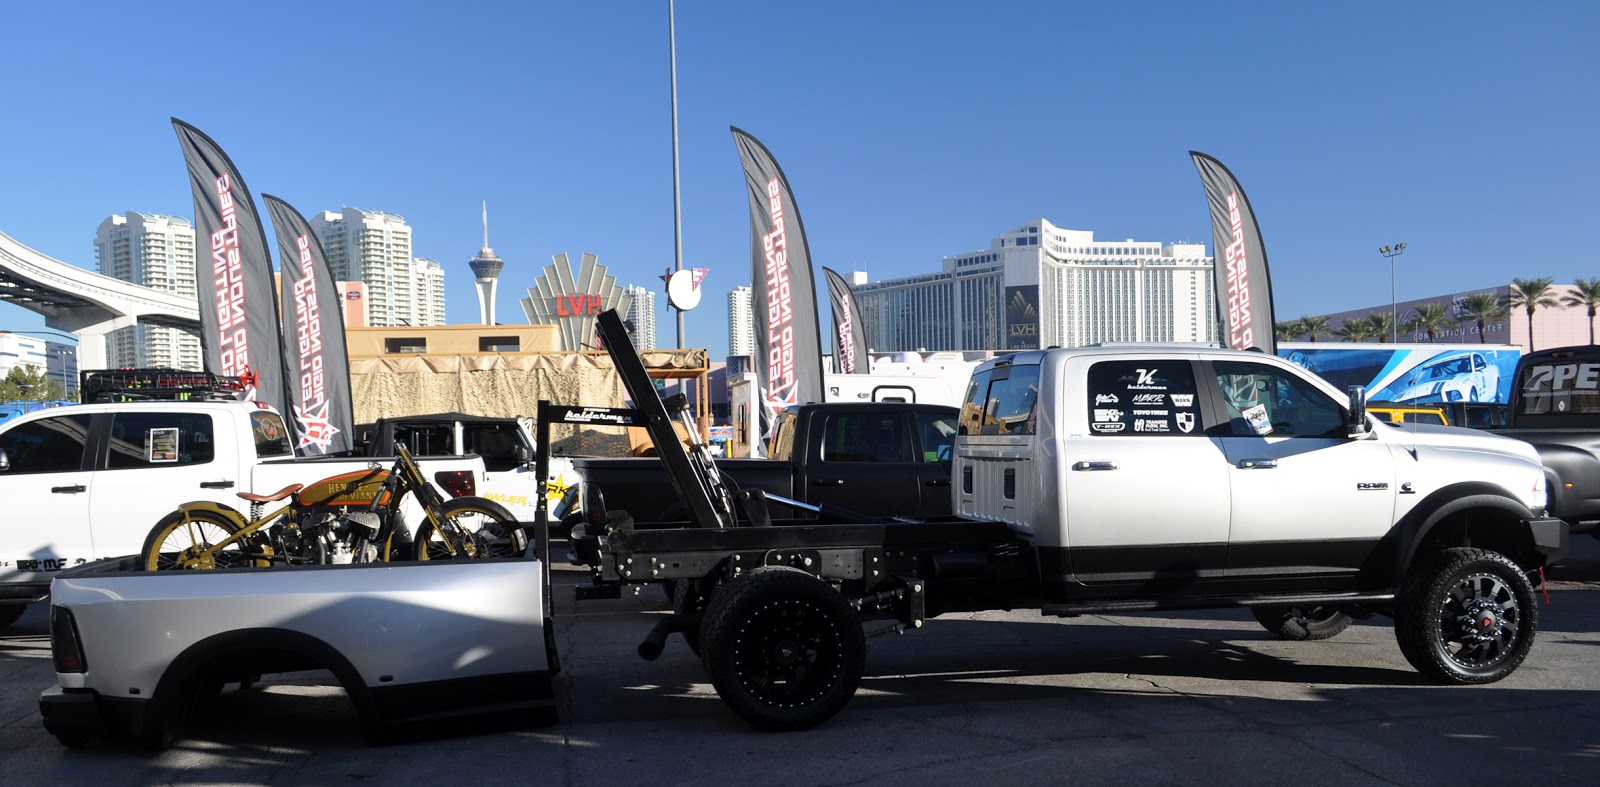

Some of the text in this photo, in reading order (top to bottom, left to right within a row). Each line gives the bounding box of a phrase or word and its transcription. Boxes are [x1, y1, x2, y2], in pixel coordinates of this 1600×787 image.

[556, 293, 602, 317] LVH
[1011, 325, 1035, 334] LVH
[1413, 327, 1465, 341] CONENTION
[1523, 363, 1600, 391] PPE
